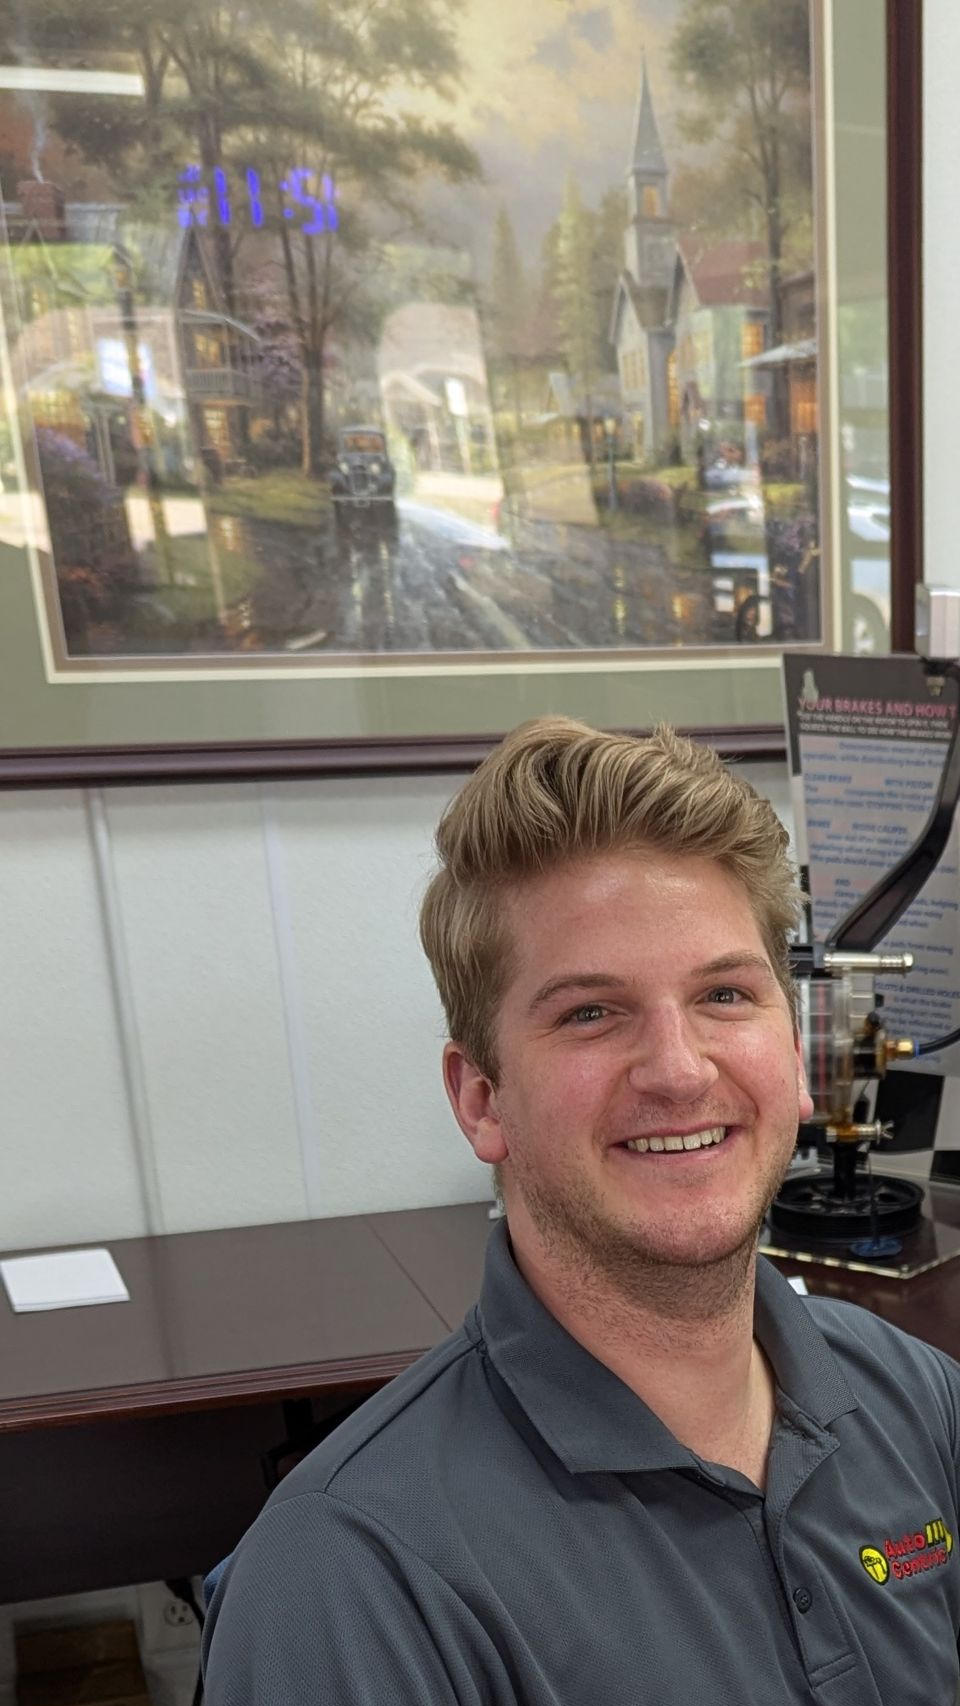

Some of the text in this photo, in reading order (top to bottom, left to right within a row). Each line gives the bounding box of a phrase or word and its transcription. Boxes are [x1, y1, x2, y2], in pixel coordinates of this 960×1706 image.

[799, 697, 832, 711] YOUR
[834, 699, 882, 714] BRAKES
[885, 702, 913, 716] AND
[915, 704, 948, 718] HOW
[883, 1532, 927, 1560] Auto
